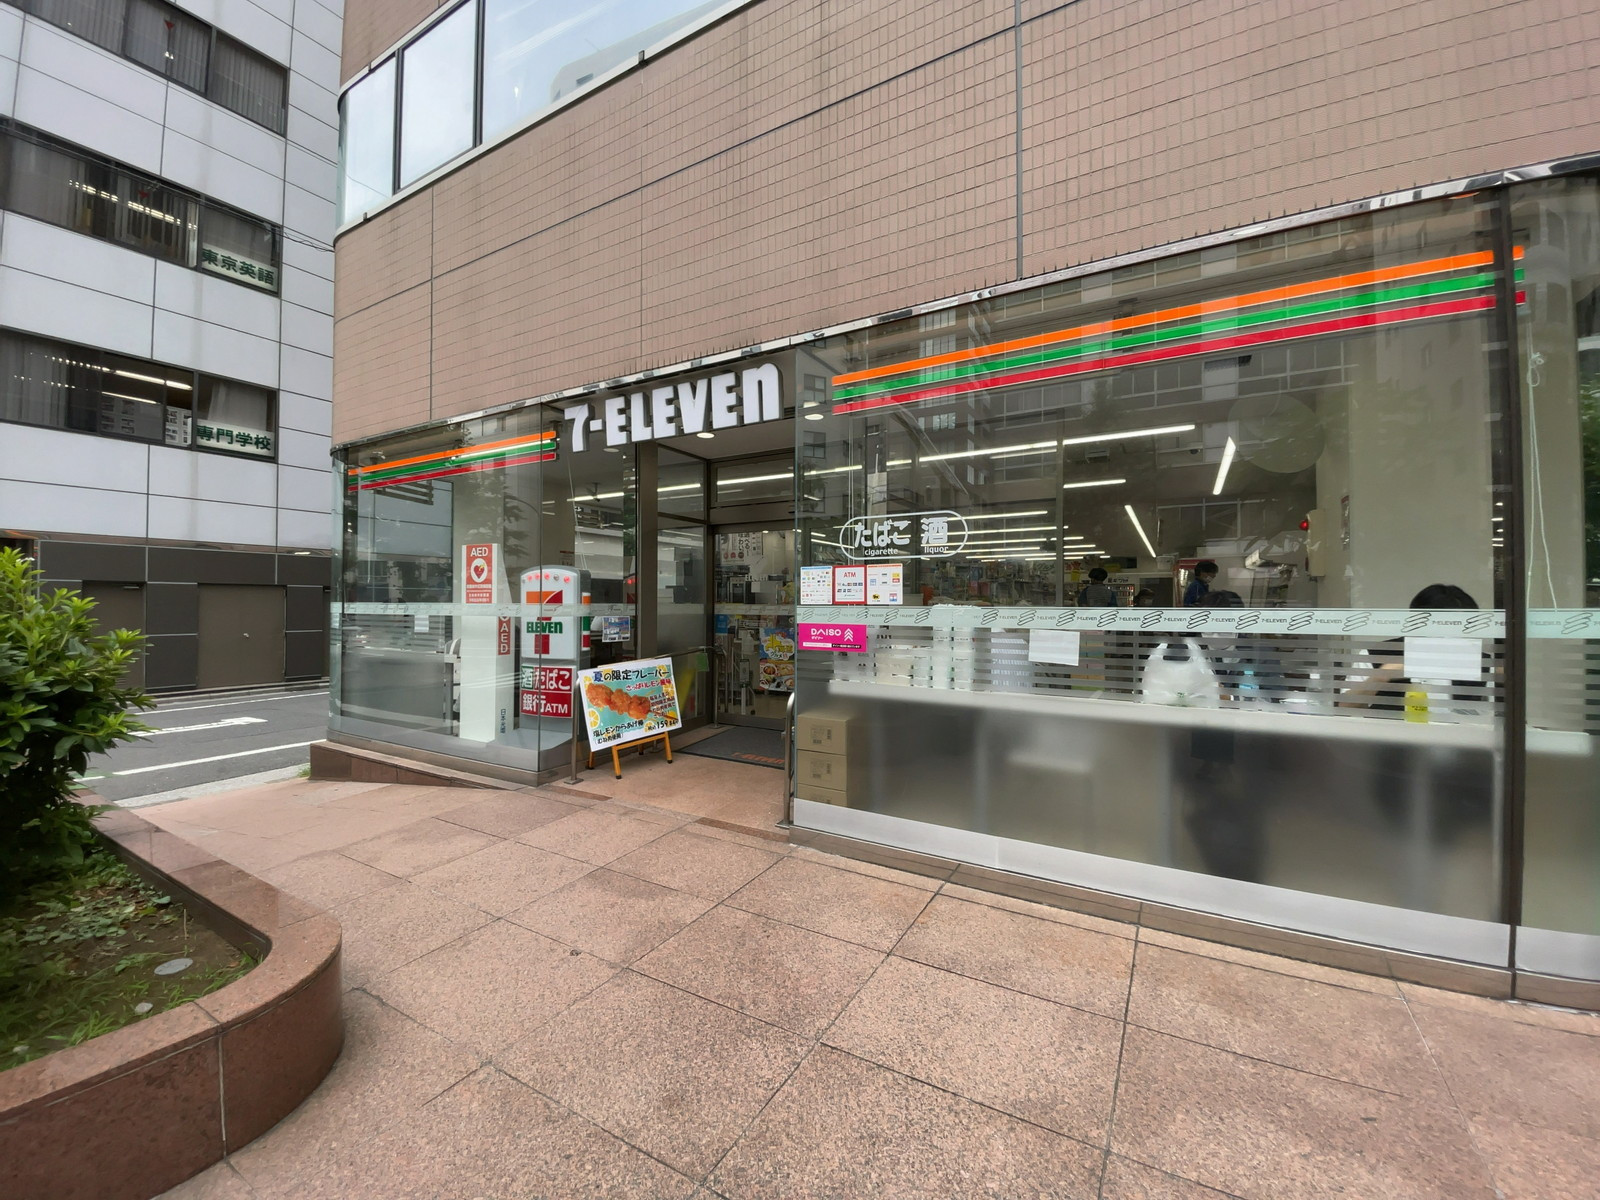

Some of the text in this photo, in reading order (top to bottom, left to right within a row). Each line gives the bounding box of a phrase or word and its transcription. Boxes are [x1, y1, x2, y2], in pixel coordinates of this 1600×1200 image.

[202, 248, 274, 286] 東京英語
[197, 424, 271, 451] 専門学校
[854, 516, 948, 547] たばこ 酒
[470, 547, 488, 557] AED
[864, 546, 949, 556] cigarette liquor
[500, 623, 508, 653] AED
[810, 628, 842, 636] DAISO
[521, 667, 571, 690] 酒 たばこ
[593, 669, 670, 682] 夏の限定フレーバー
